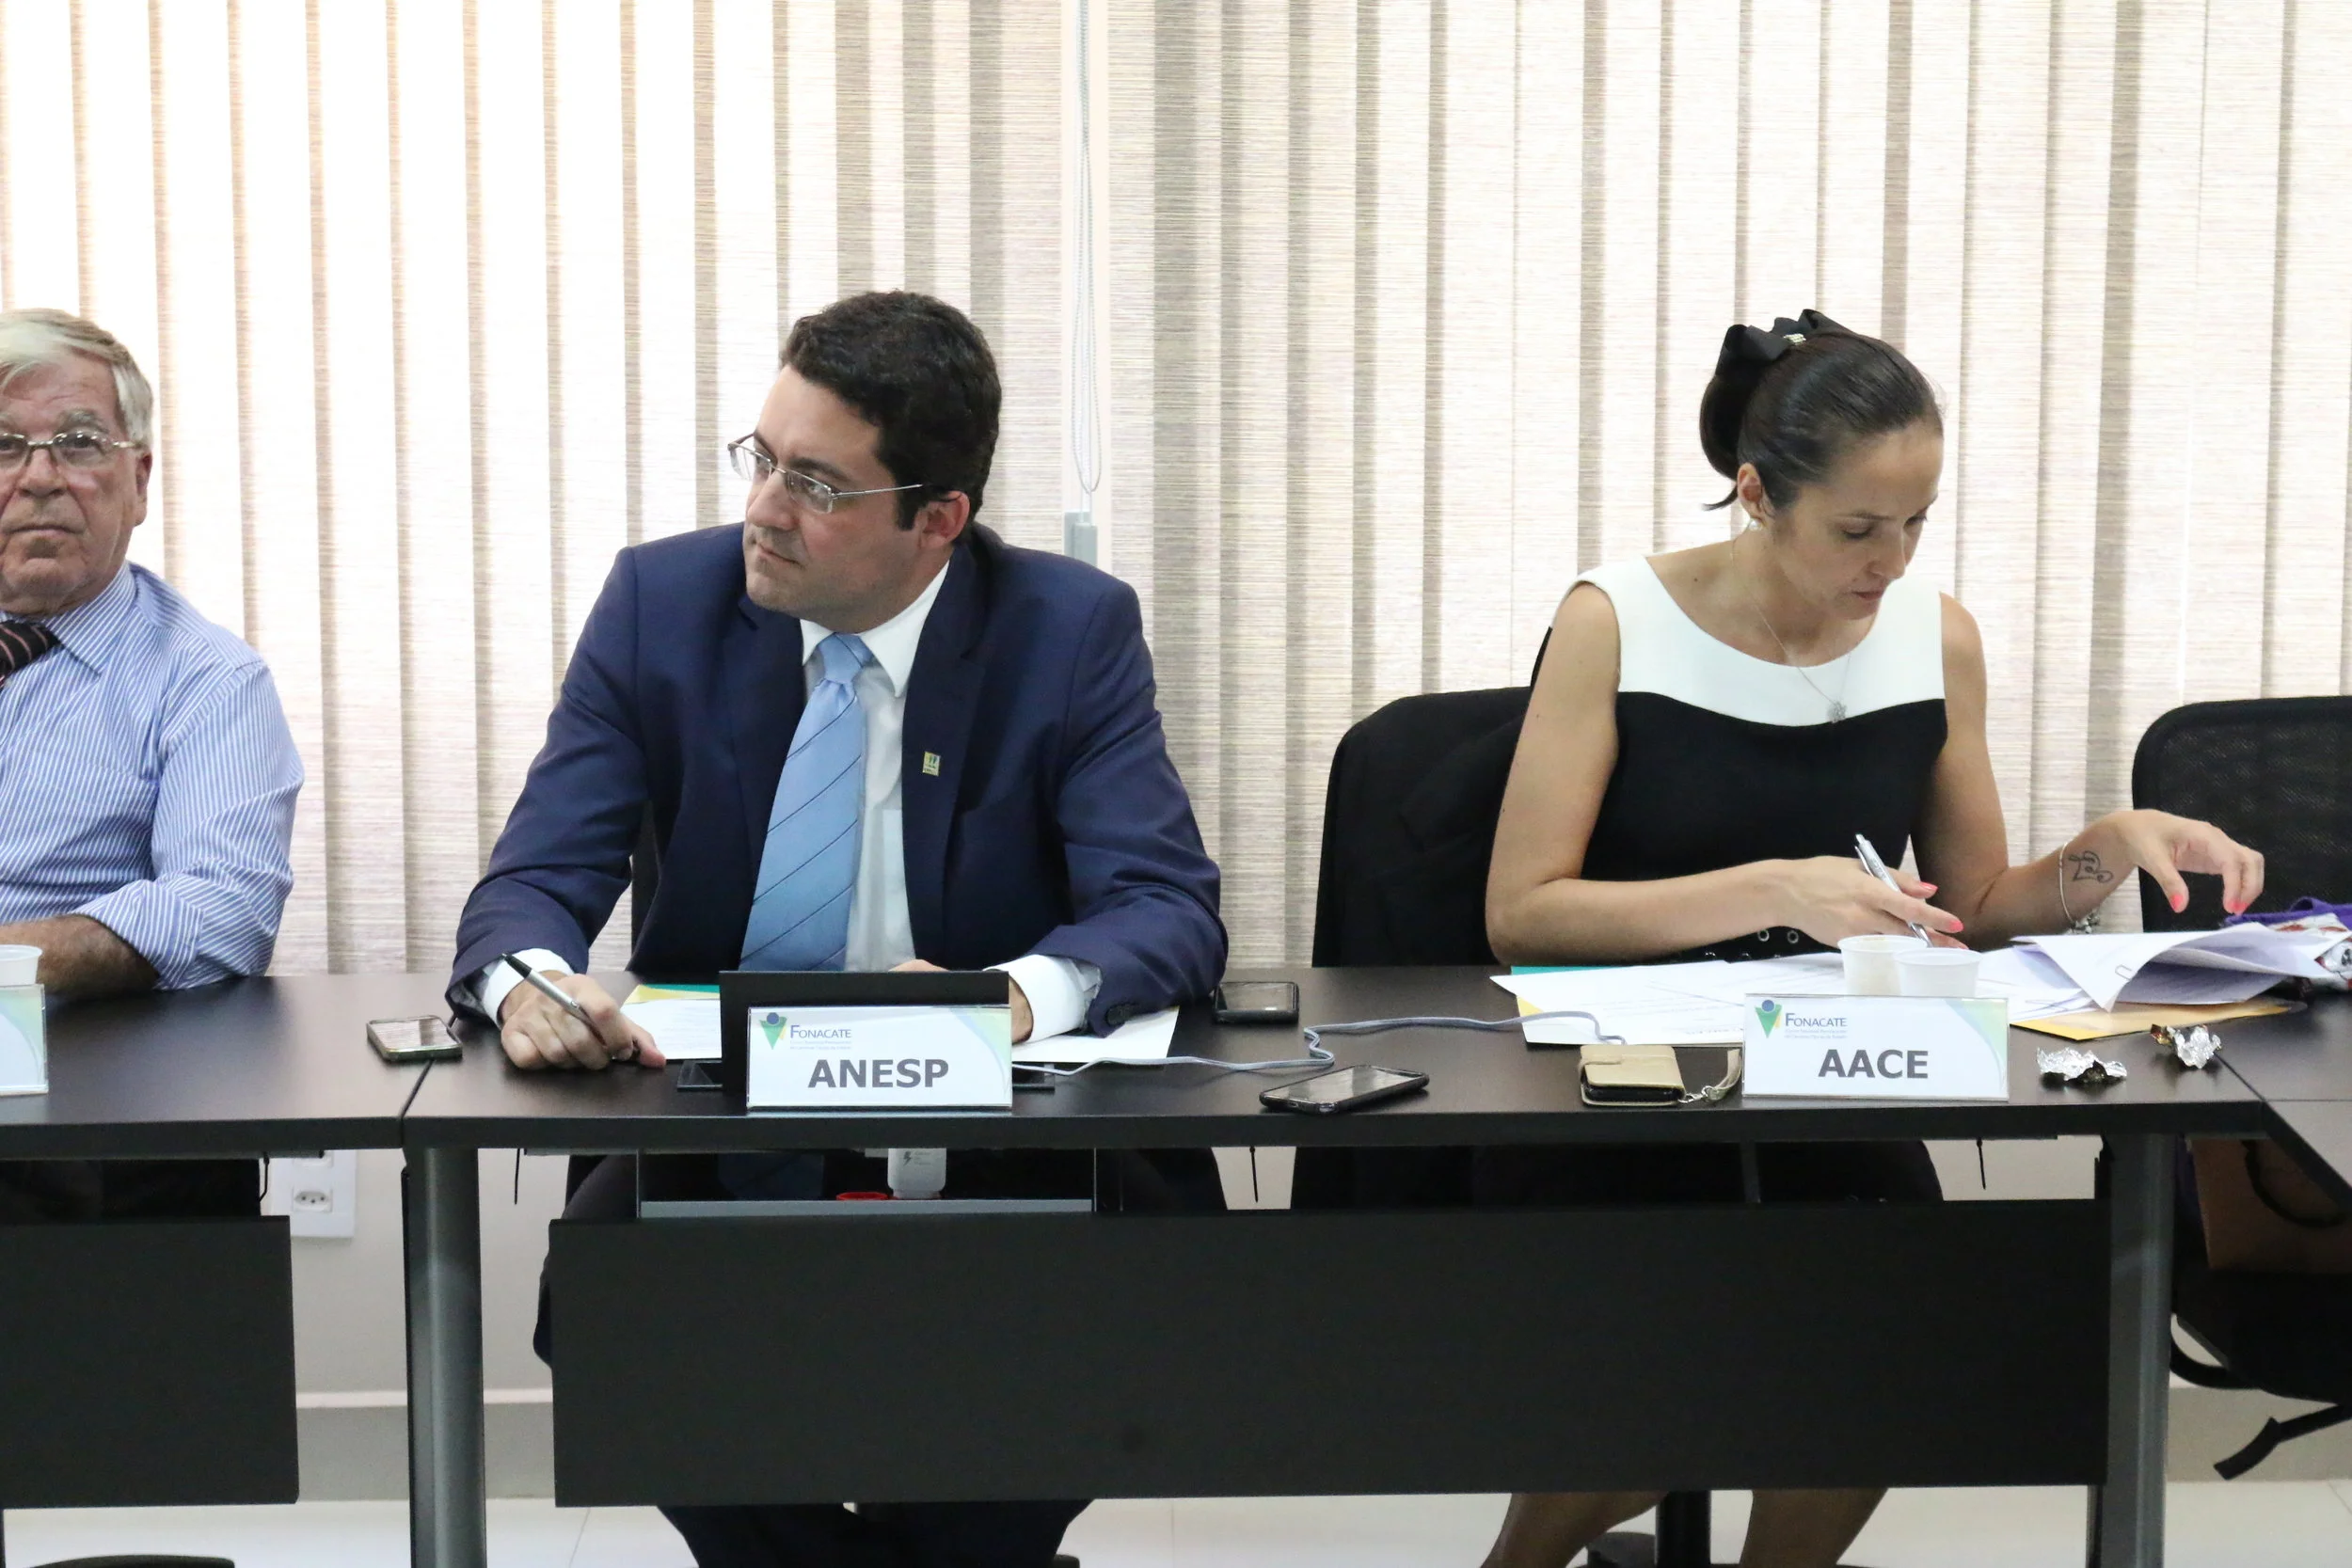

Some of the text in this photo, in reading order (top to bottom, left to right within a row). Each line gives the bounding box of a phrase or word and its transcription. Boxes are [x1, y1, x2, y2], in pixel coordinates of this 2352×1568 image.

[1785, 1012, 1848, 1027] FONACATE
[790, 1024, 852, 1038] FONACATE
[807, 1058, 949, 1088] ANESP
[1818, 1049, 1929, 1079] AACE
